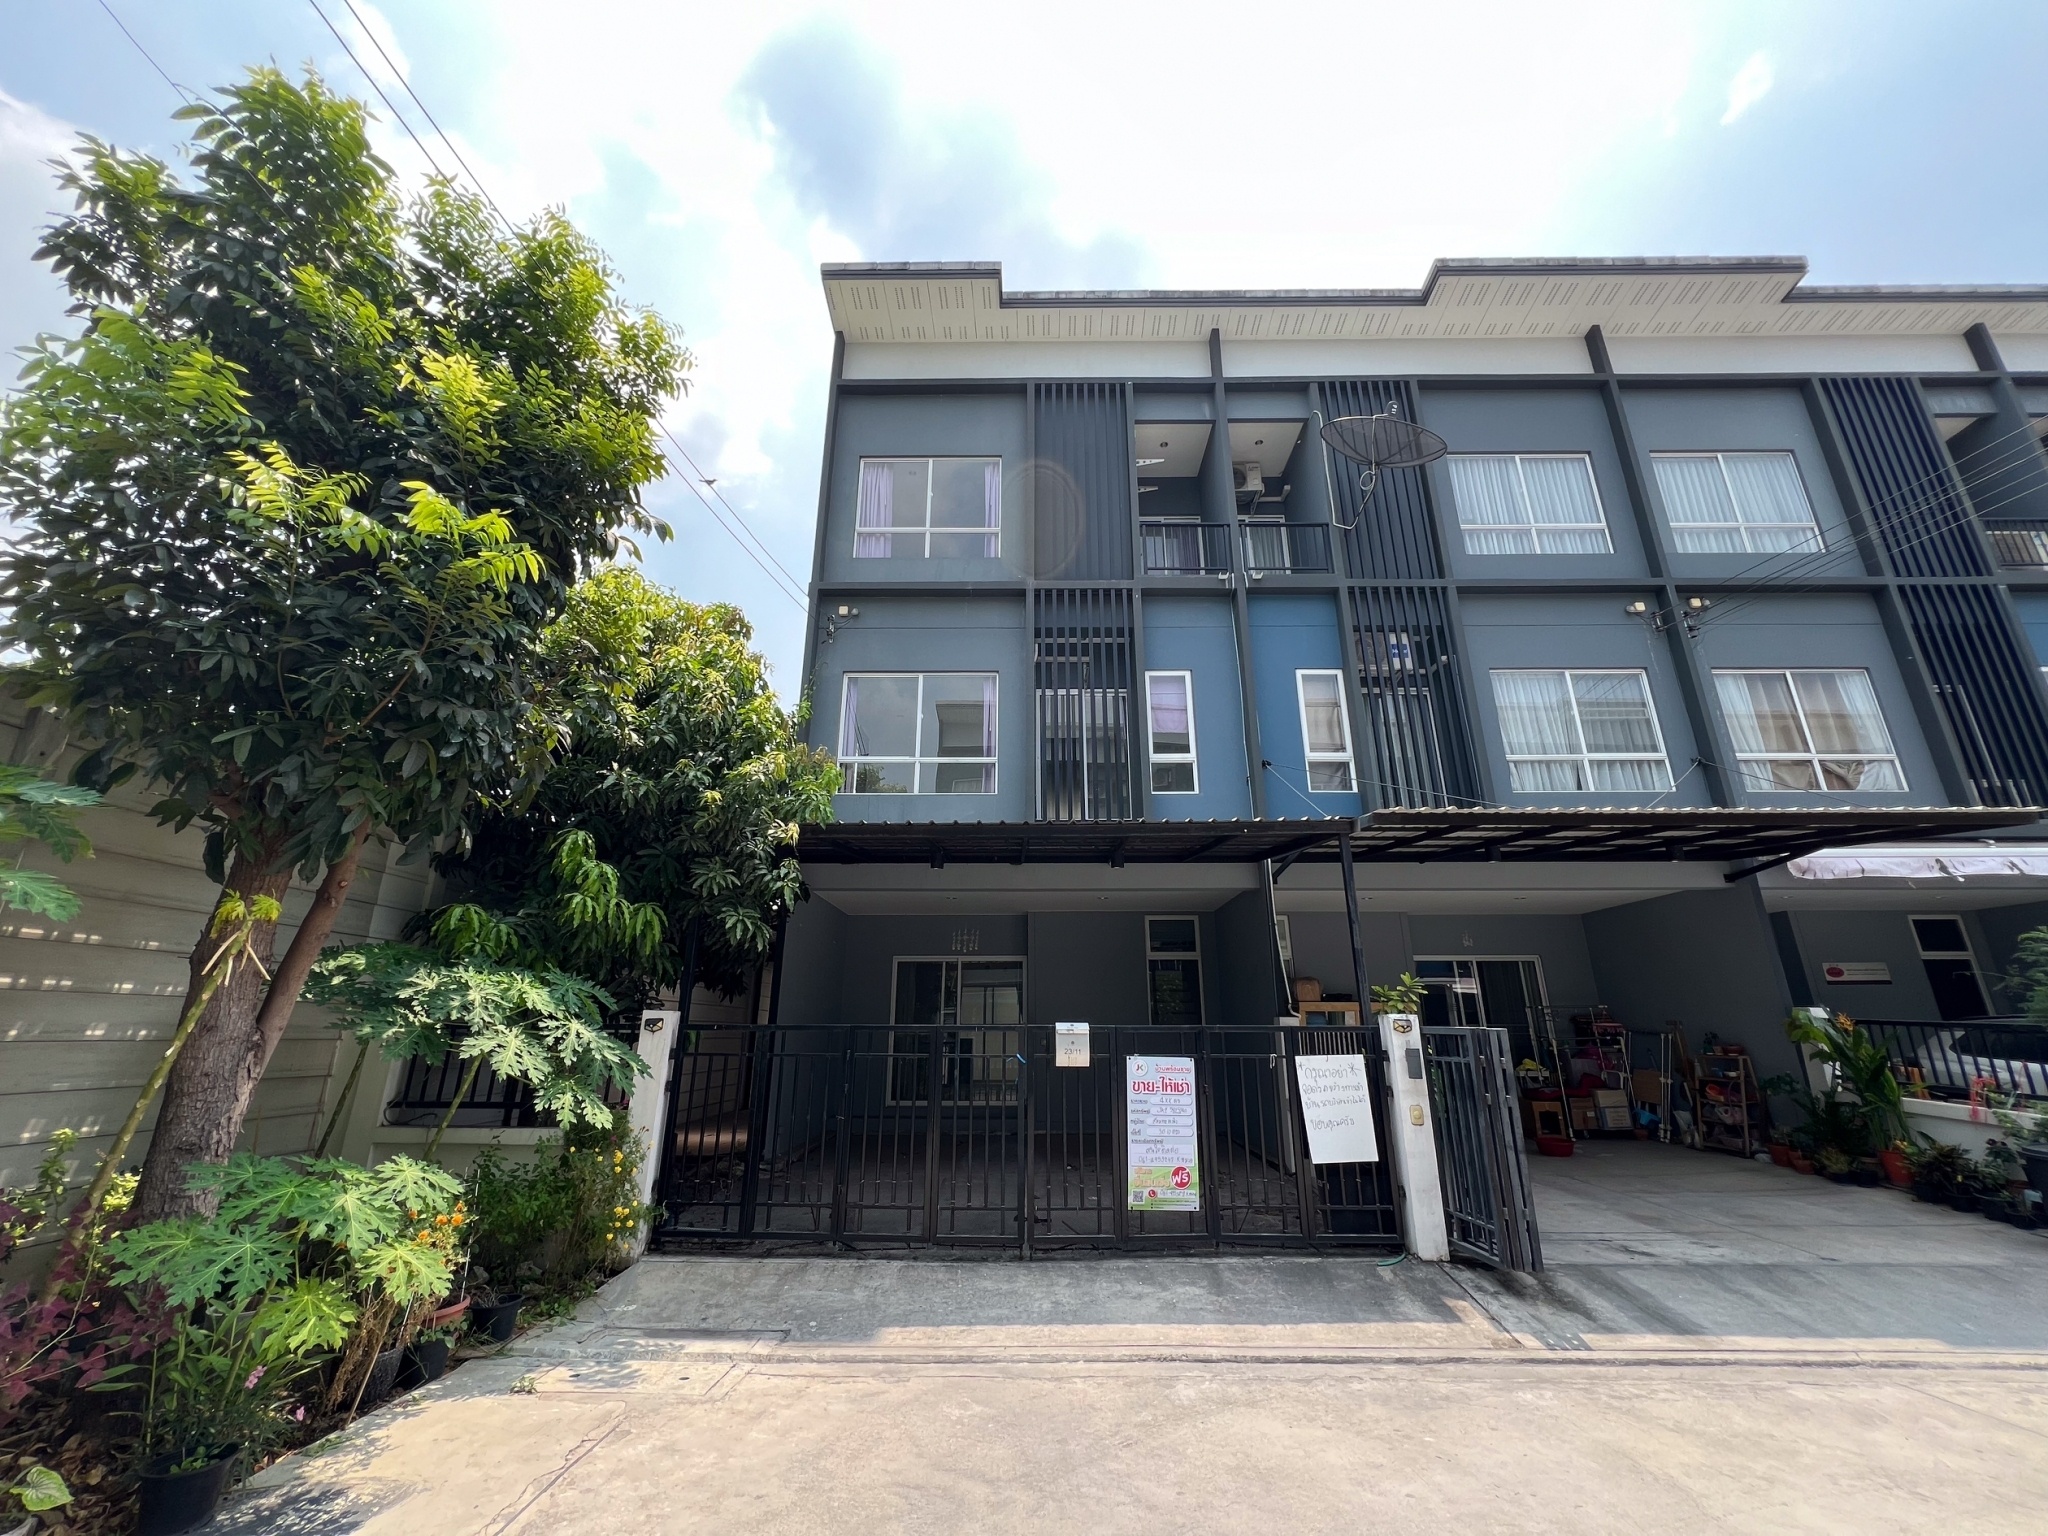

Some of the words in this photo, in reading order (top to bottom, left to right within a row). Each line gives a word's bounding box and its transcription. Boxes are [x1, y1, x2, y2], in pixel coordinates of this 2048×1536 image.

[1132, 1076, 1190, 1093] ขาย-ให้เช่า
[1172, 1168, 1189, 1184] ฟรี
